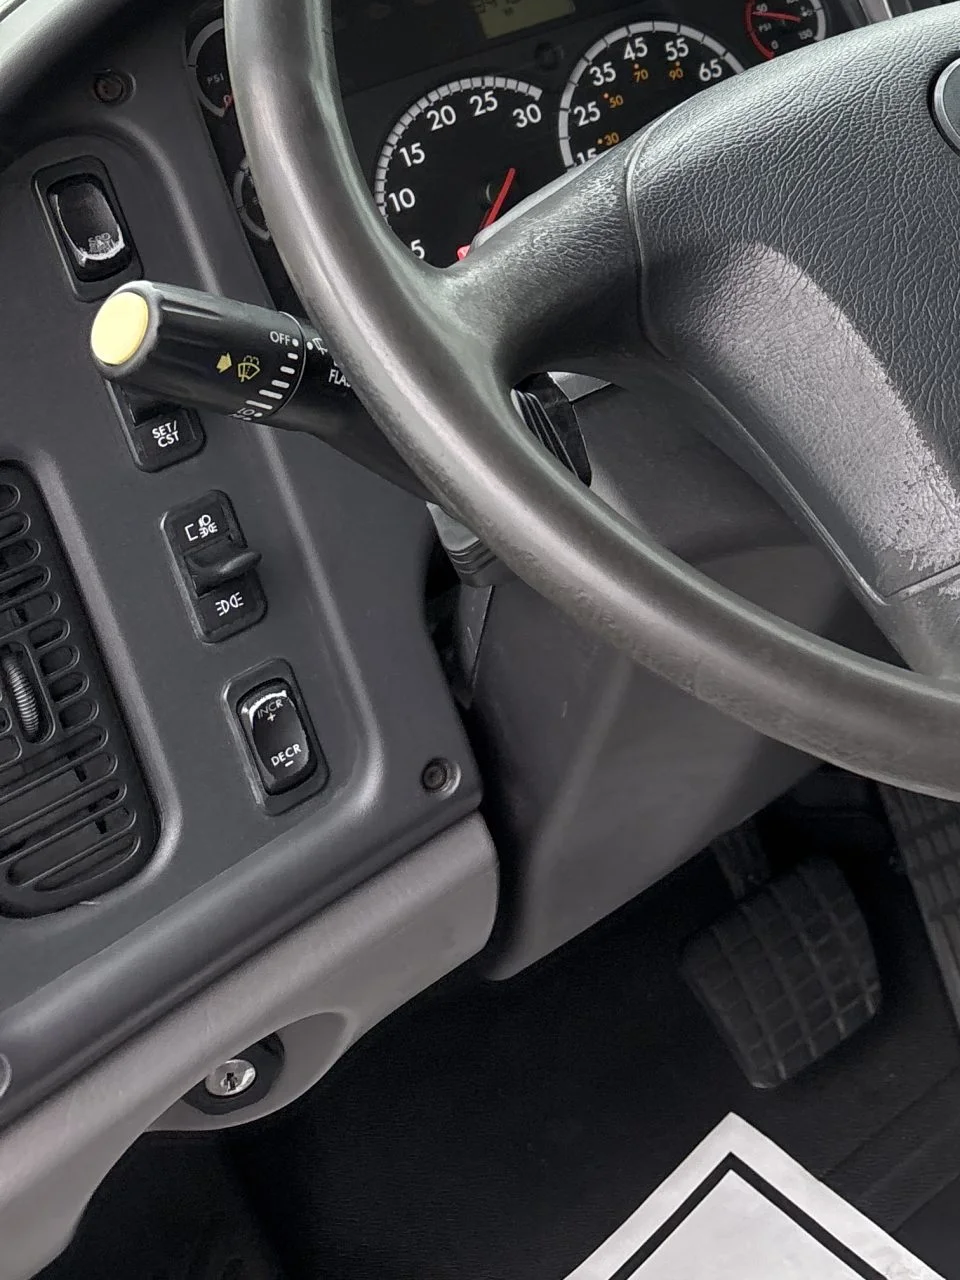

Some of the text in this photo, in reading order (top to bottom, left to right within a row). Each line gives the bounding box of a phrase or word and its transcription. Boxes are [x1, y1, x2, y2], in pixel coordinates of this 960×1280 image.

[624, 37, 648, 61] 45
[665, 37, 689, 61] 55
[206, 72, 224, 85] PSI
[589, 61, 616, 86] 35
[633, 69, 649, 83] 70
[669, 70, 684, 82] 90
[699, 59, 723, 82] 65
[469, 90, 498, 116] 25
[573, 101, 601, 126] 25
[609, 95, 624, 109] 50
[427, 105, 456, 131] 20
[512, 103, 542, 128] 30
[604, 131, 620, 146] 30
[399, 142, 425, 167] 15
[388, 187, 416, 212] 10
[411, 239, 425, 259] 5
[269, 330, 291, 347] OFF
[151, 420, 178, 439] SET/
[157, 430, 180, 448] CST
[257, 699, 284, 720] INCR
[270, 743, 302, 767] DECR
